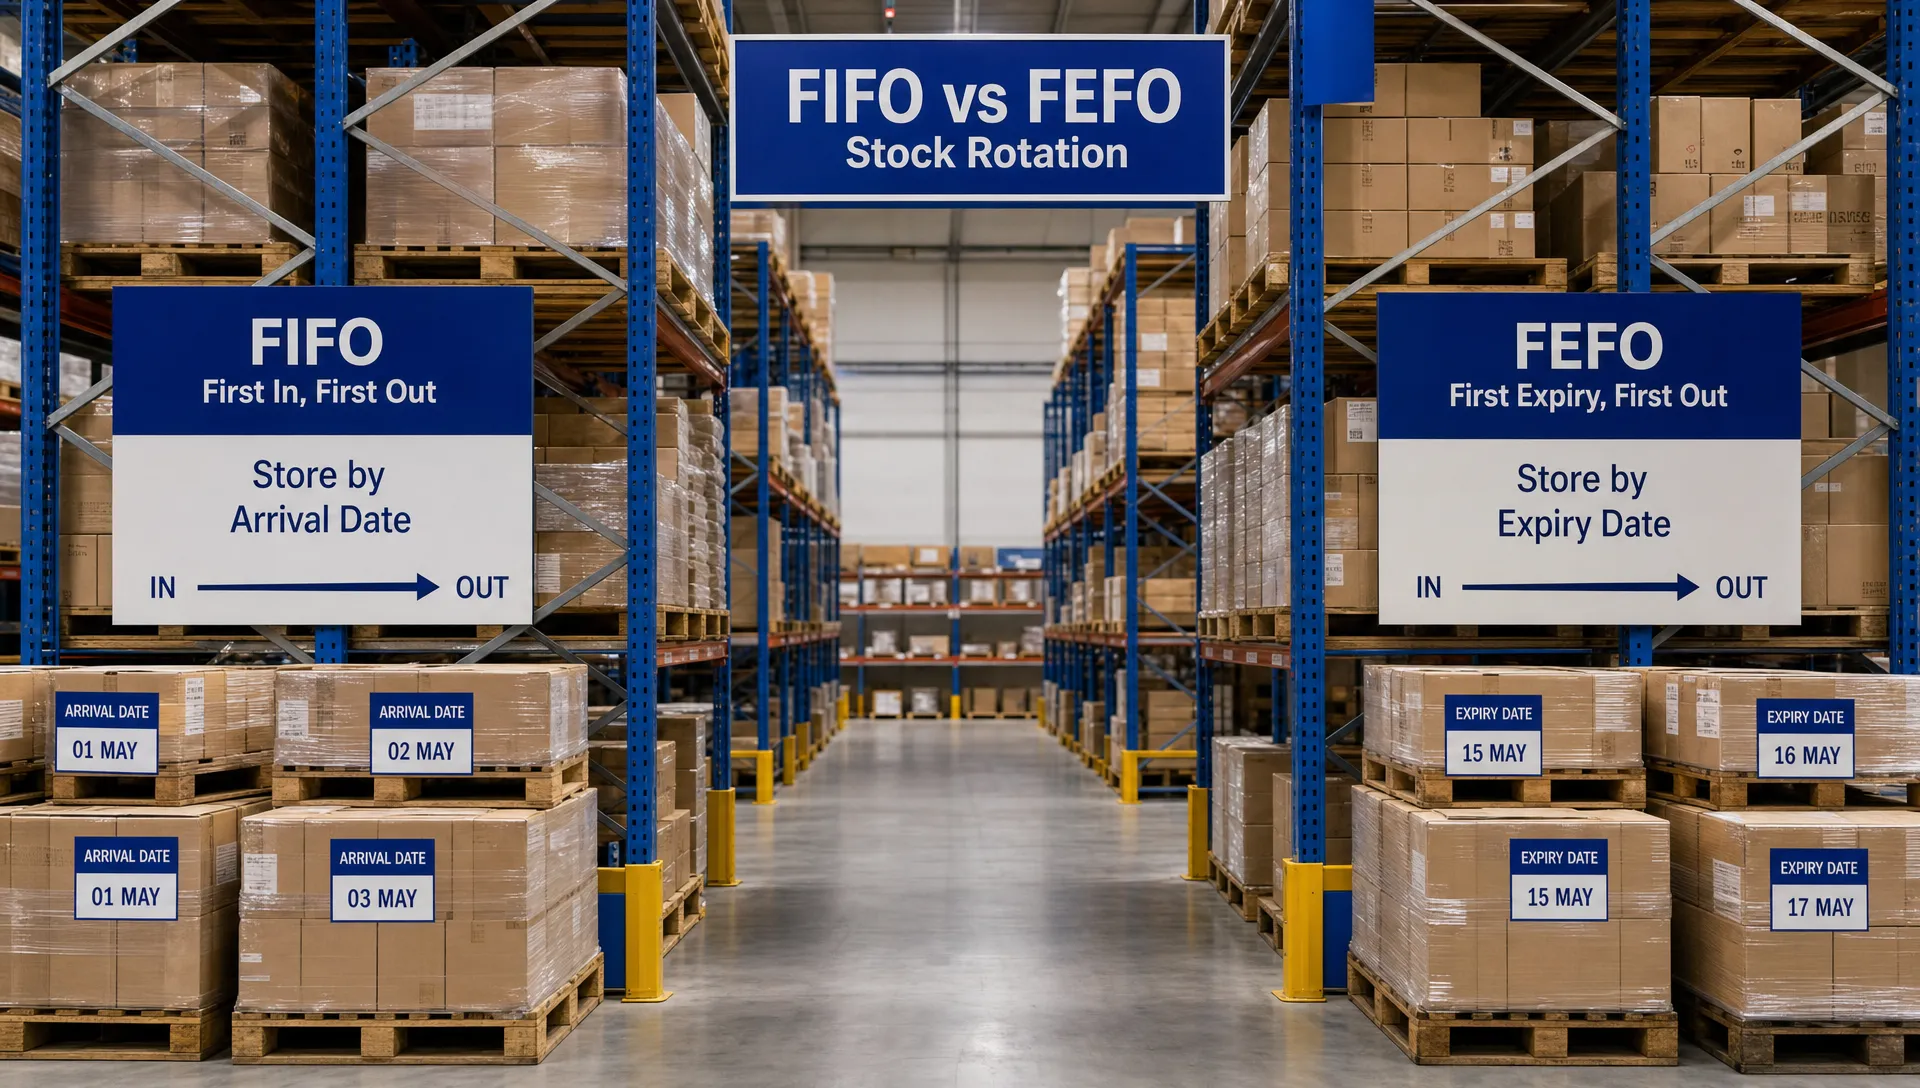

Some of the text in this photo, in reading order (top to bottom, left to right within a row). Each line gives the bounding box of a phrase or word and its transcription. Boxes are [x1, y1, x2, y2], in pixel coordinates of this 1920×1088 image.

[788, 67, 1182, 124] FIFO vs FEFO
[846, 135, 1128, 169] Stock Rotation
[251, 317, 384, 367] FIFO
[1516, 321, 1663, 371] FEFO
[203, 378, 437, 408] First In, First Out
[1450, 382, 1728, 414] First Expiry, First Out
[252, 459, 386, 496] Store by
[1517, 463, 1648, 500] Store by
[230, 504, 411, 534] Arrival Date
[1498, 509, 1671, 545] Expiry Date
[150, 575, 175, 599] IN
[456, 575, 510, 599] OUT
[1417, 575, 1441, 599] IN
[1715, 575, 1768, 599] OUT
[64, 705, 149, 719] ARRIVAL DATE
[379, 705, 465, 719] ARRIVAL DATE
[1455, 706, 1533, 720] EXPIRY DATE
[1767, 710, 1845, 724] EXPIRY DATE
[72, 740, 138, 760] 01 MAY
[387, 741, 455, 761] 02 MAY
[1462, 743, 1527, 763] 15 MAY
[1774, 745, 1841, 765] 16 MAY
[83, 849, 171, 863] ARRIVAL DATE
[339, 851, 426, 865] ARRIVAL DATE
[1521, 851, 1599, 865] EXPIRY DATE
[1780, 861, 1858, 875] EXPIRY DATE
[91, 886, 161, 906] 01 MAY
[347, 888, 418, 908] 03 MAY
[1527, 887, 1594, 907] 15 MAY
[1787, 897, 1854, 917] 17 MAY
